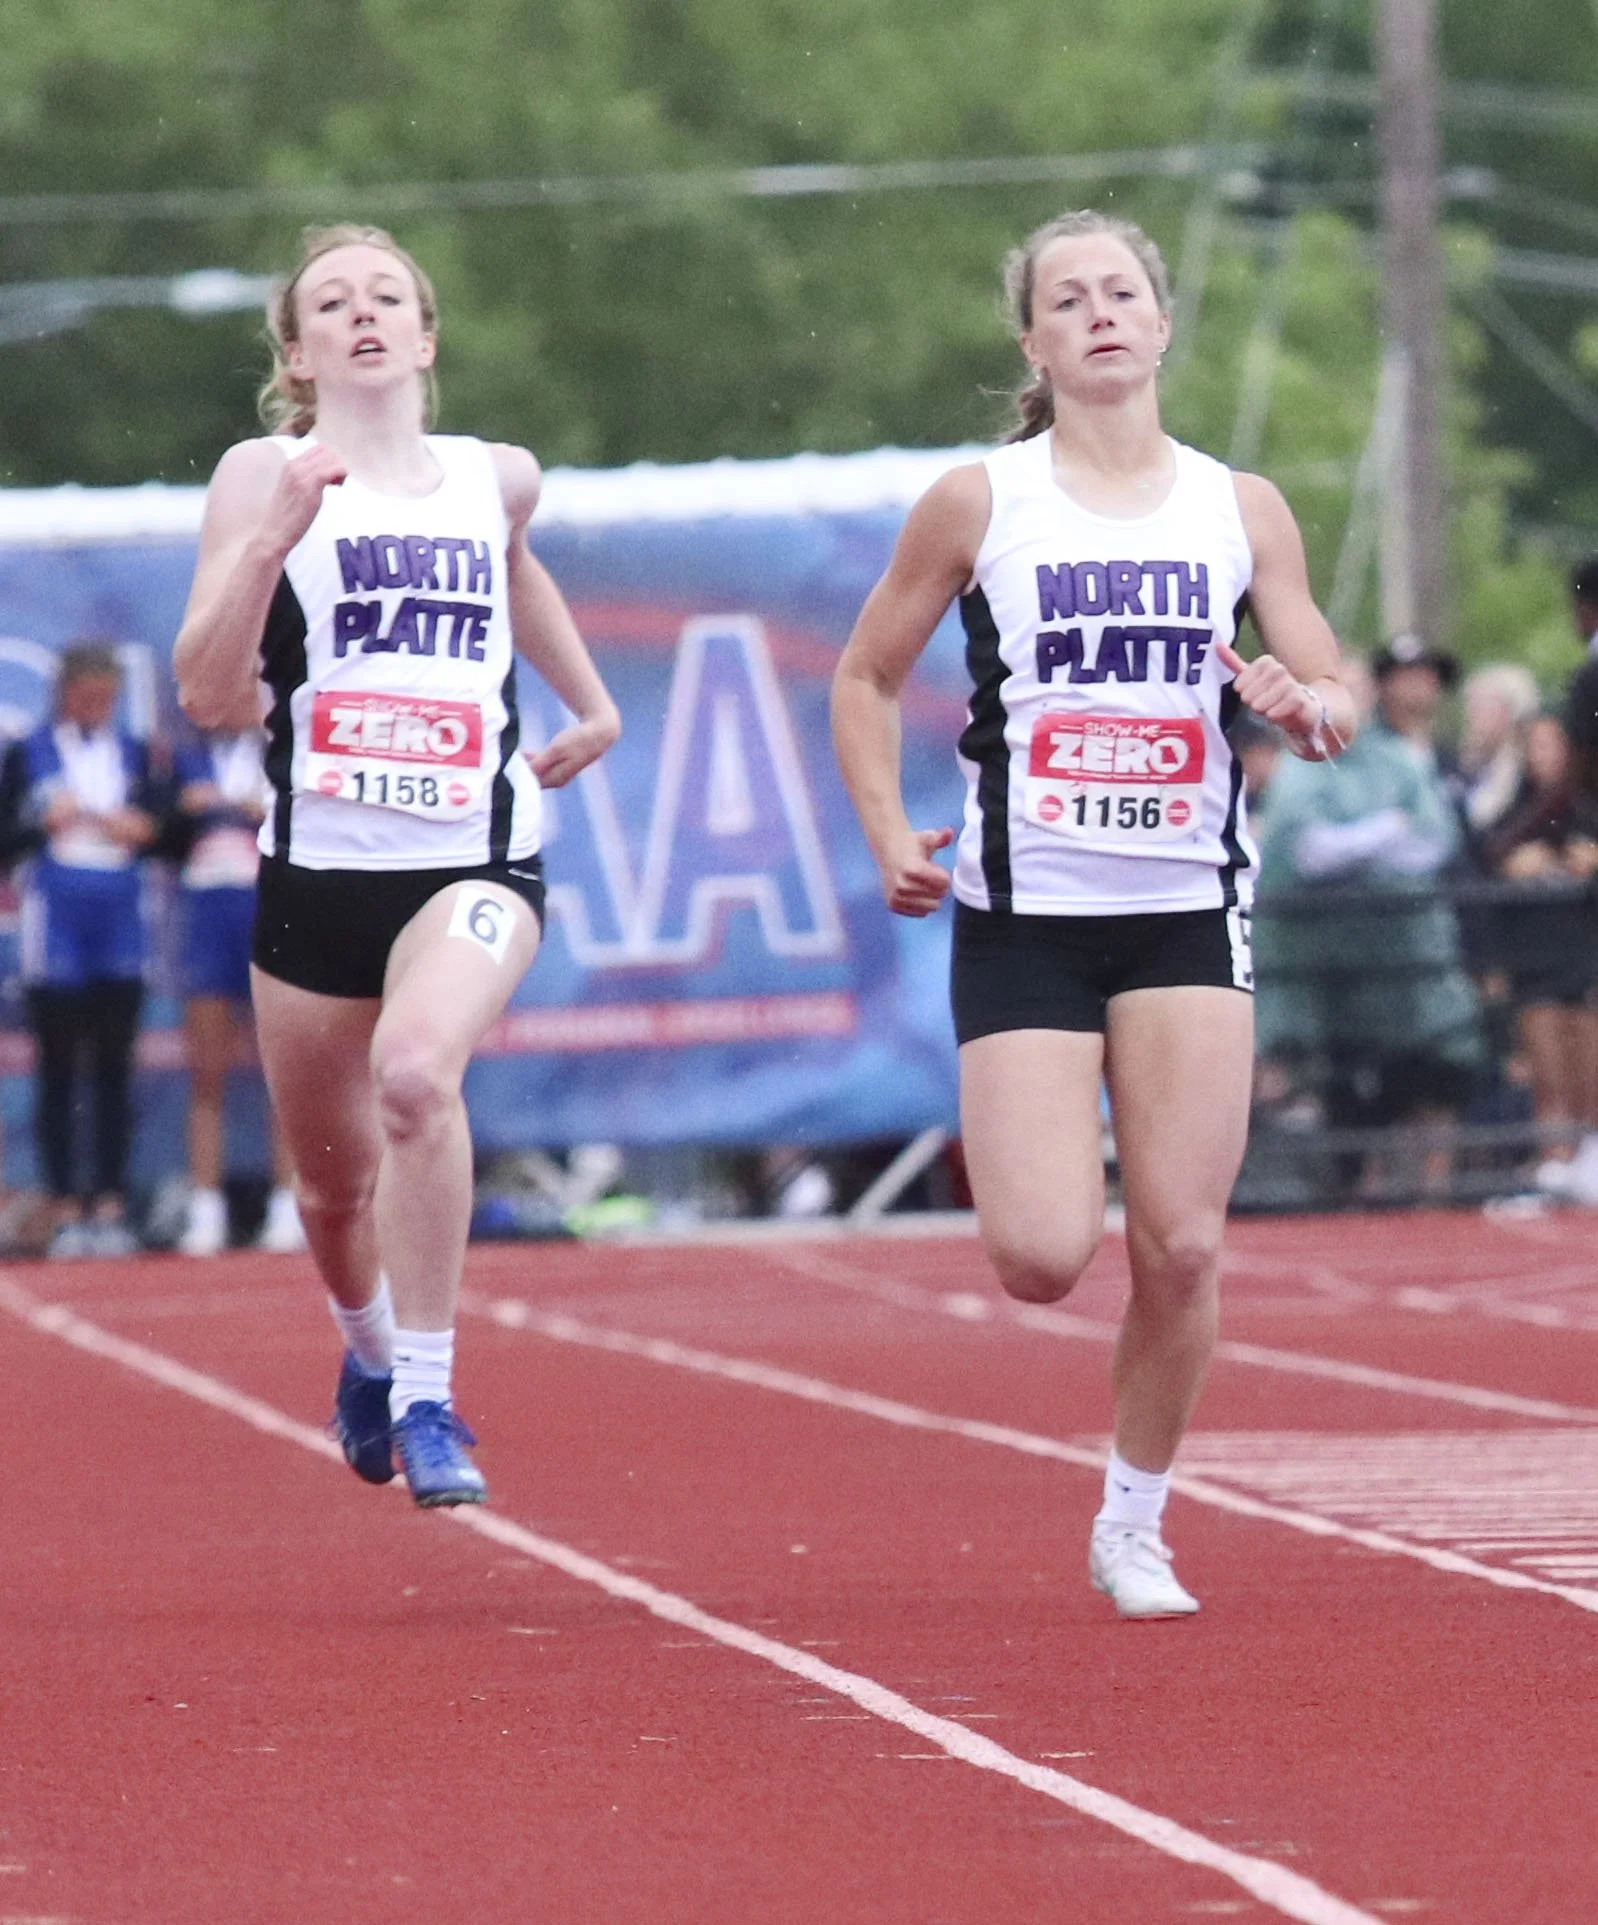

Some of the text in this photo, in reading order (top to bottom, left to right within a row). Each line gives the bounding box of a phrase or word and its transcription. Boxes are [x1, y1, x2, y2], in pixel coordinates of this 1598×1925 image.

[335, 534, 492, 595] NORTH
[1036, 560, 1210, 622] NORTH
[334, 597, 493, 663] PLATTE
[1036, 626, 1213, 686] PLATTE
[327, 708, 468, 757] ZERO
[1047, 731, 1190, 775] ZERO
[1083, 722, 1161, 738] SHOW-ME
[350, 771, 441, 808] 1158
[1071, 794, 1162, 830] 1156
[468, 898, 505, 946] 6
